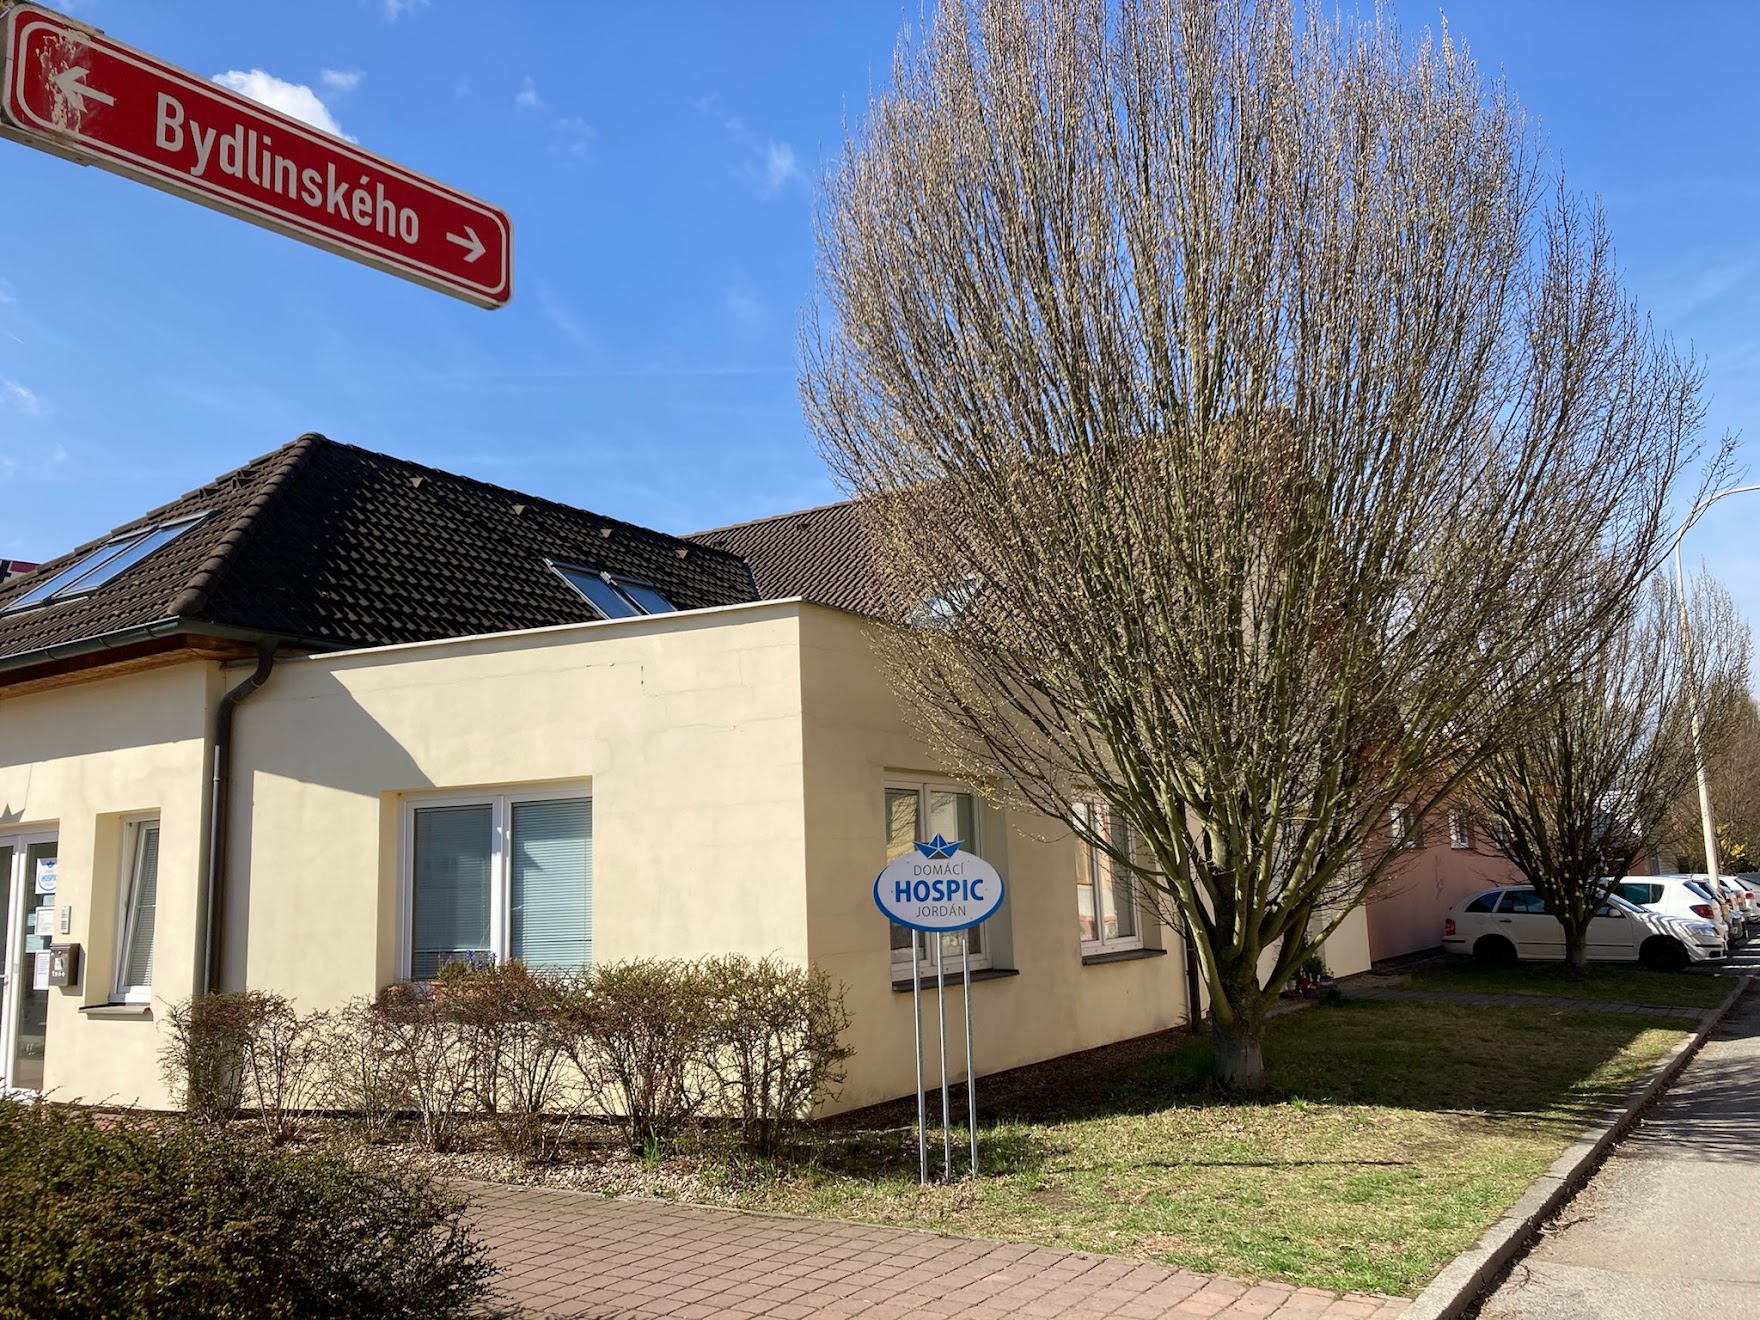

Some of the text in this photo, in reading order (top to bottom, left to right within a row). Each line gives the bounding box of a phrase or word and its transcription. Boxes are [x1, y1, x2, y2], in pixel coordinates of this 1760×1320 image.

[156, 92, 419, 244] Bydlinského
[914, 862, 964, 875] DOMÁCÍ
[895, 879, 984, 902] HOSPIC
[916, 904, 966, 917] JORDÁN
